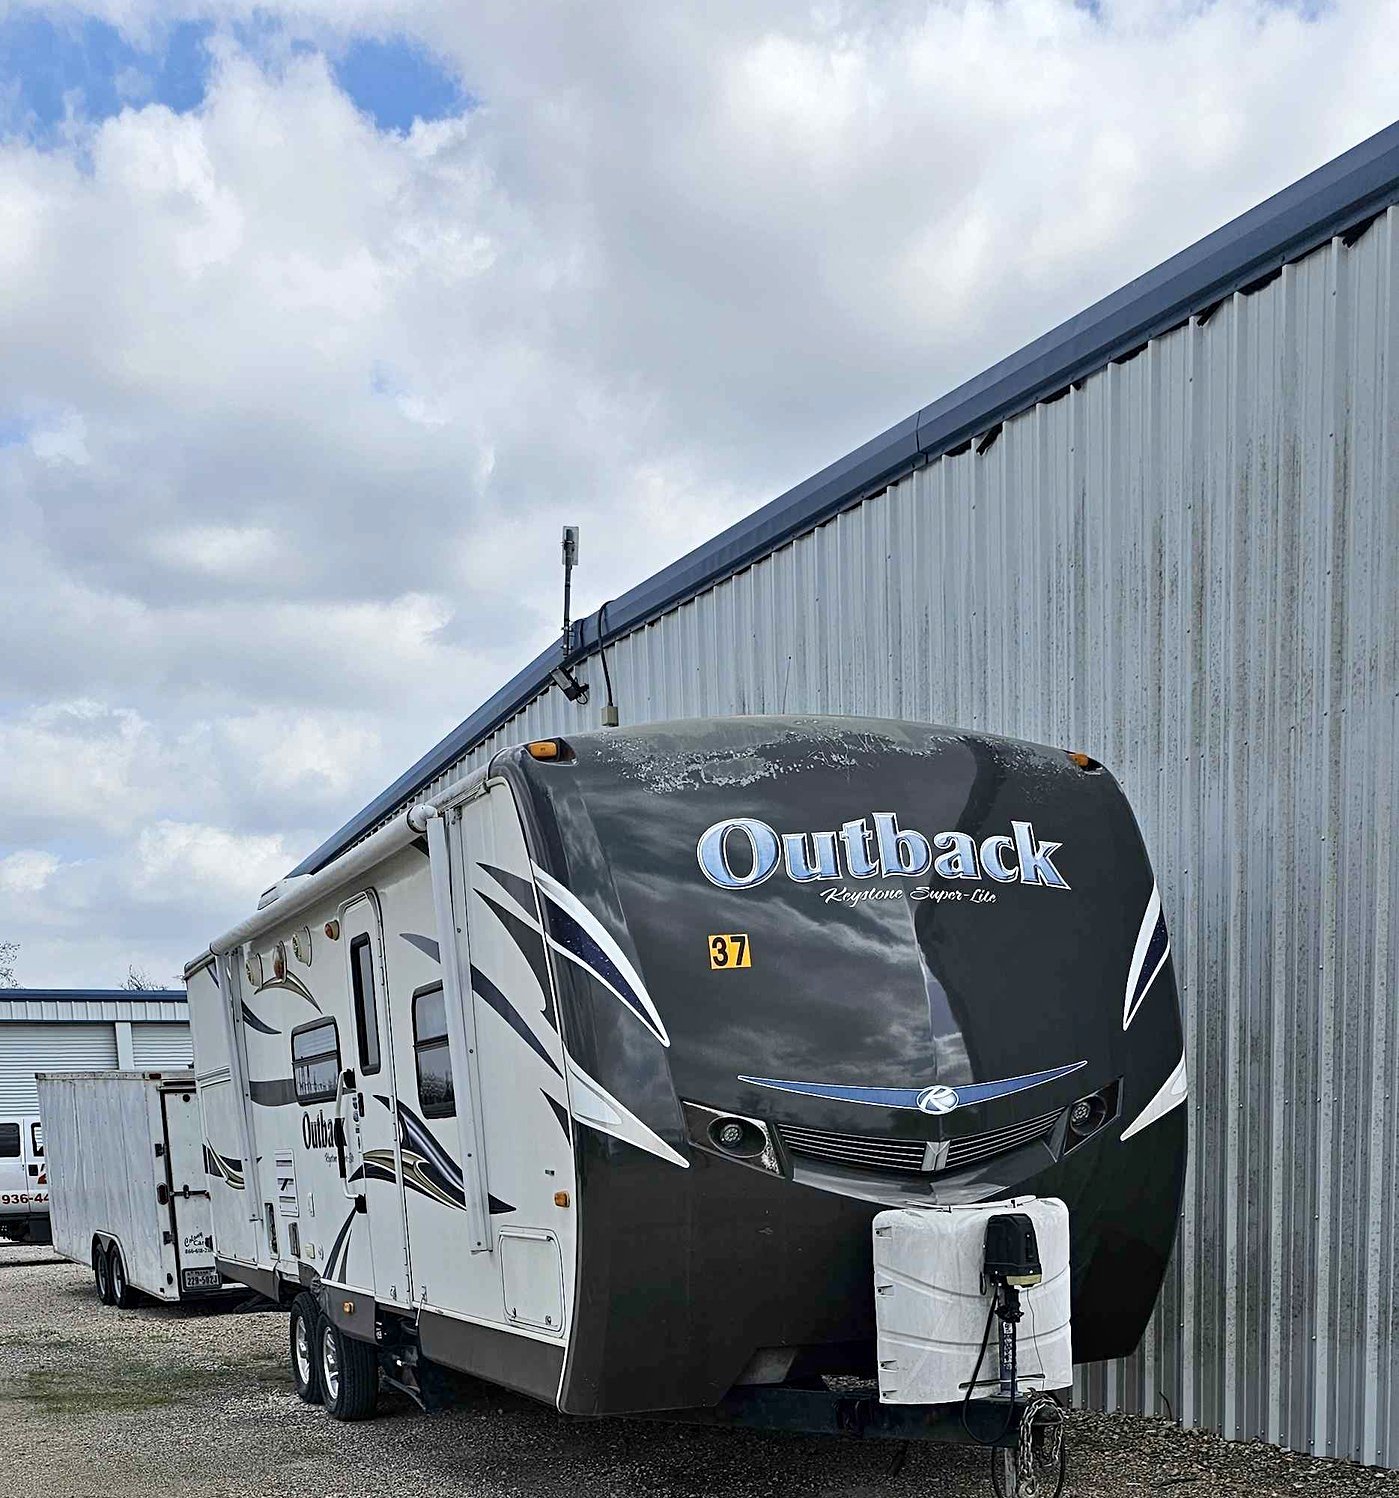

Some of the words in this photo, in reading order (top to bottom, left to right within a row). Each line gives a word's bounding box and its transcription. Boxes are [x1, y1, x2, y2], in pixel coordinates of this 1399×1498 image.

[696, 812, 1072, 890] Outback
[819, 886, 904, 908] Keystone
[910, 886, 997, 904] Super-Lite
[711, 936, 746, 967] 37
[302, 1109, 348, 1150] Outbak
[1, 1193, 49, 1205] 936-44
